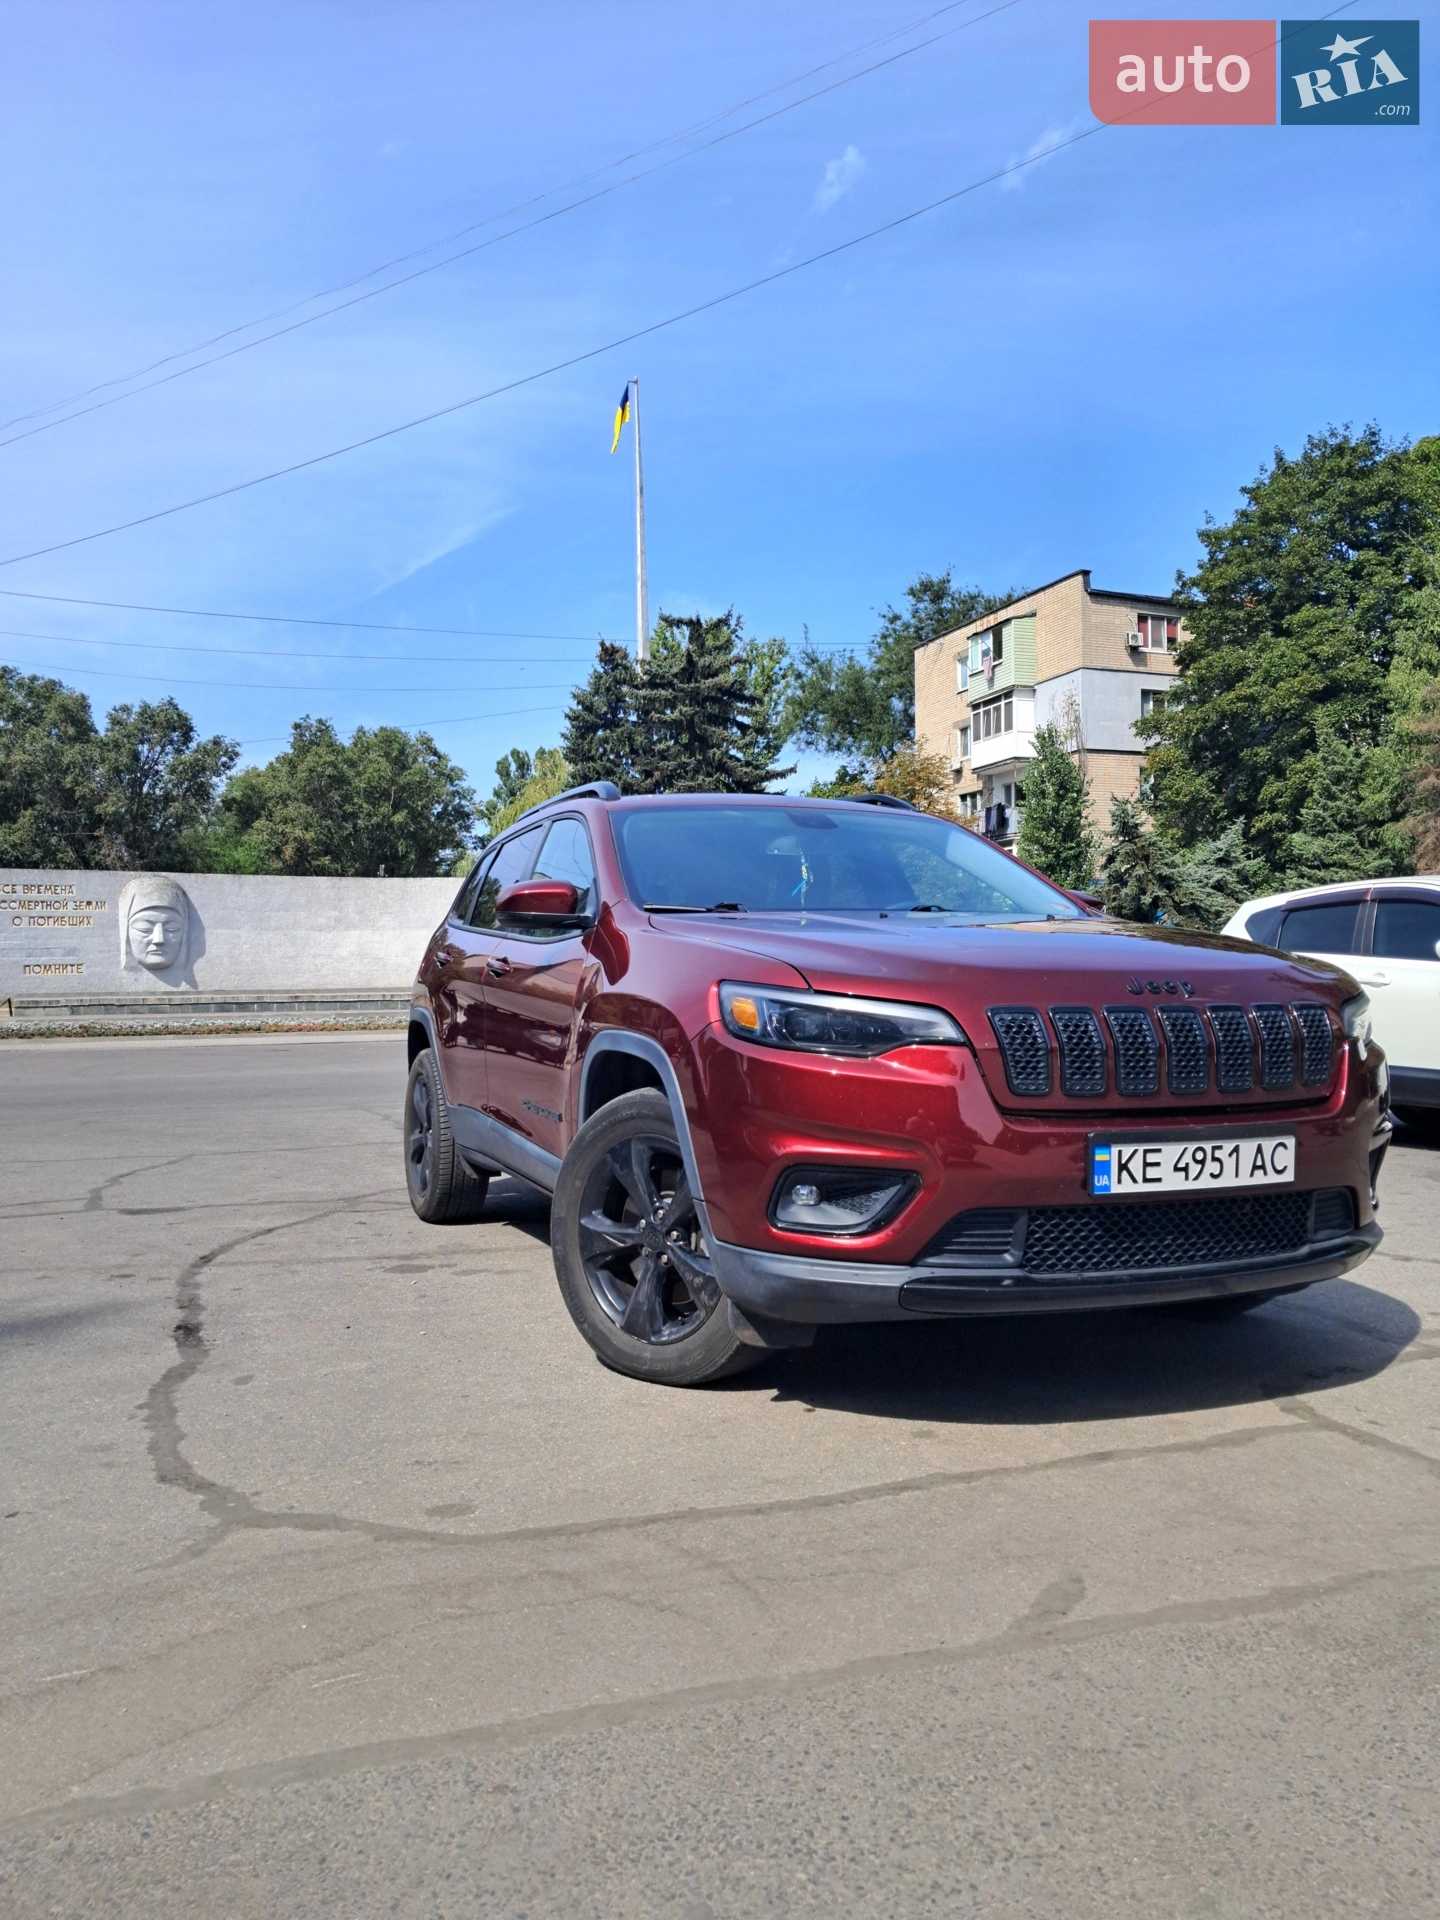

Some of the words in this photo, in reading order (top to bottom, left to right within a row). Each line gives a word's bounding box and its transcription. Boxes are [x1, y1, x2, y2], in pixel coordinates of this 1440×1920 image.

[0, 884, 18, 895] СЕ
[22, 884, 75, 895] ВРЕМЕНА
[0, 899, 68, 911] ССМЕРТНОЙ
[72, 900, 107, 911] ЗЕМЛИ
[12, 916, 23, 927] О
[28, 916, 92, 927] ПОГИБШИХ
[24, 964, 84, 975] ПОМНИТЕ
[1126, 976, 1196, 998] Jeep
[1117, 1148, 1163, 1185] KE
[1173, 1144, 1240, 1182] 4951
[1249, 1141, 1289, 1178] AC
[1094, 1175, 1110, 1186] UA
